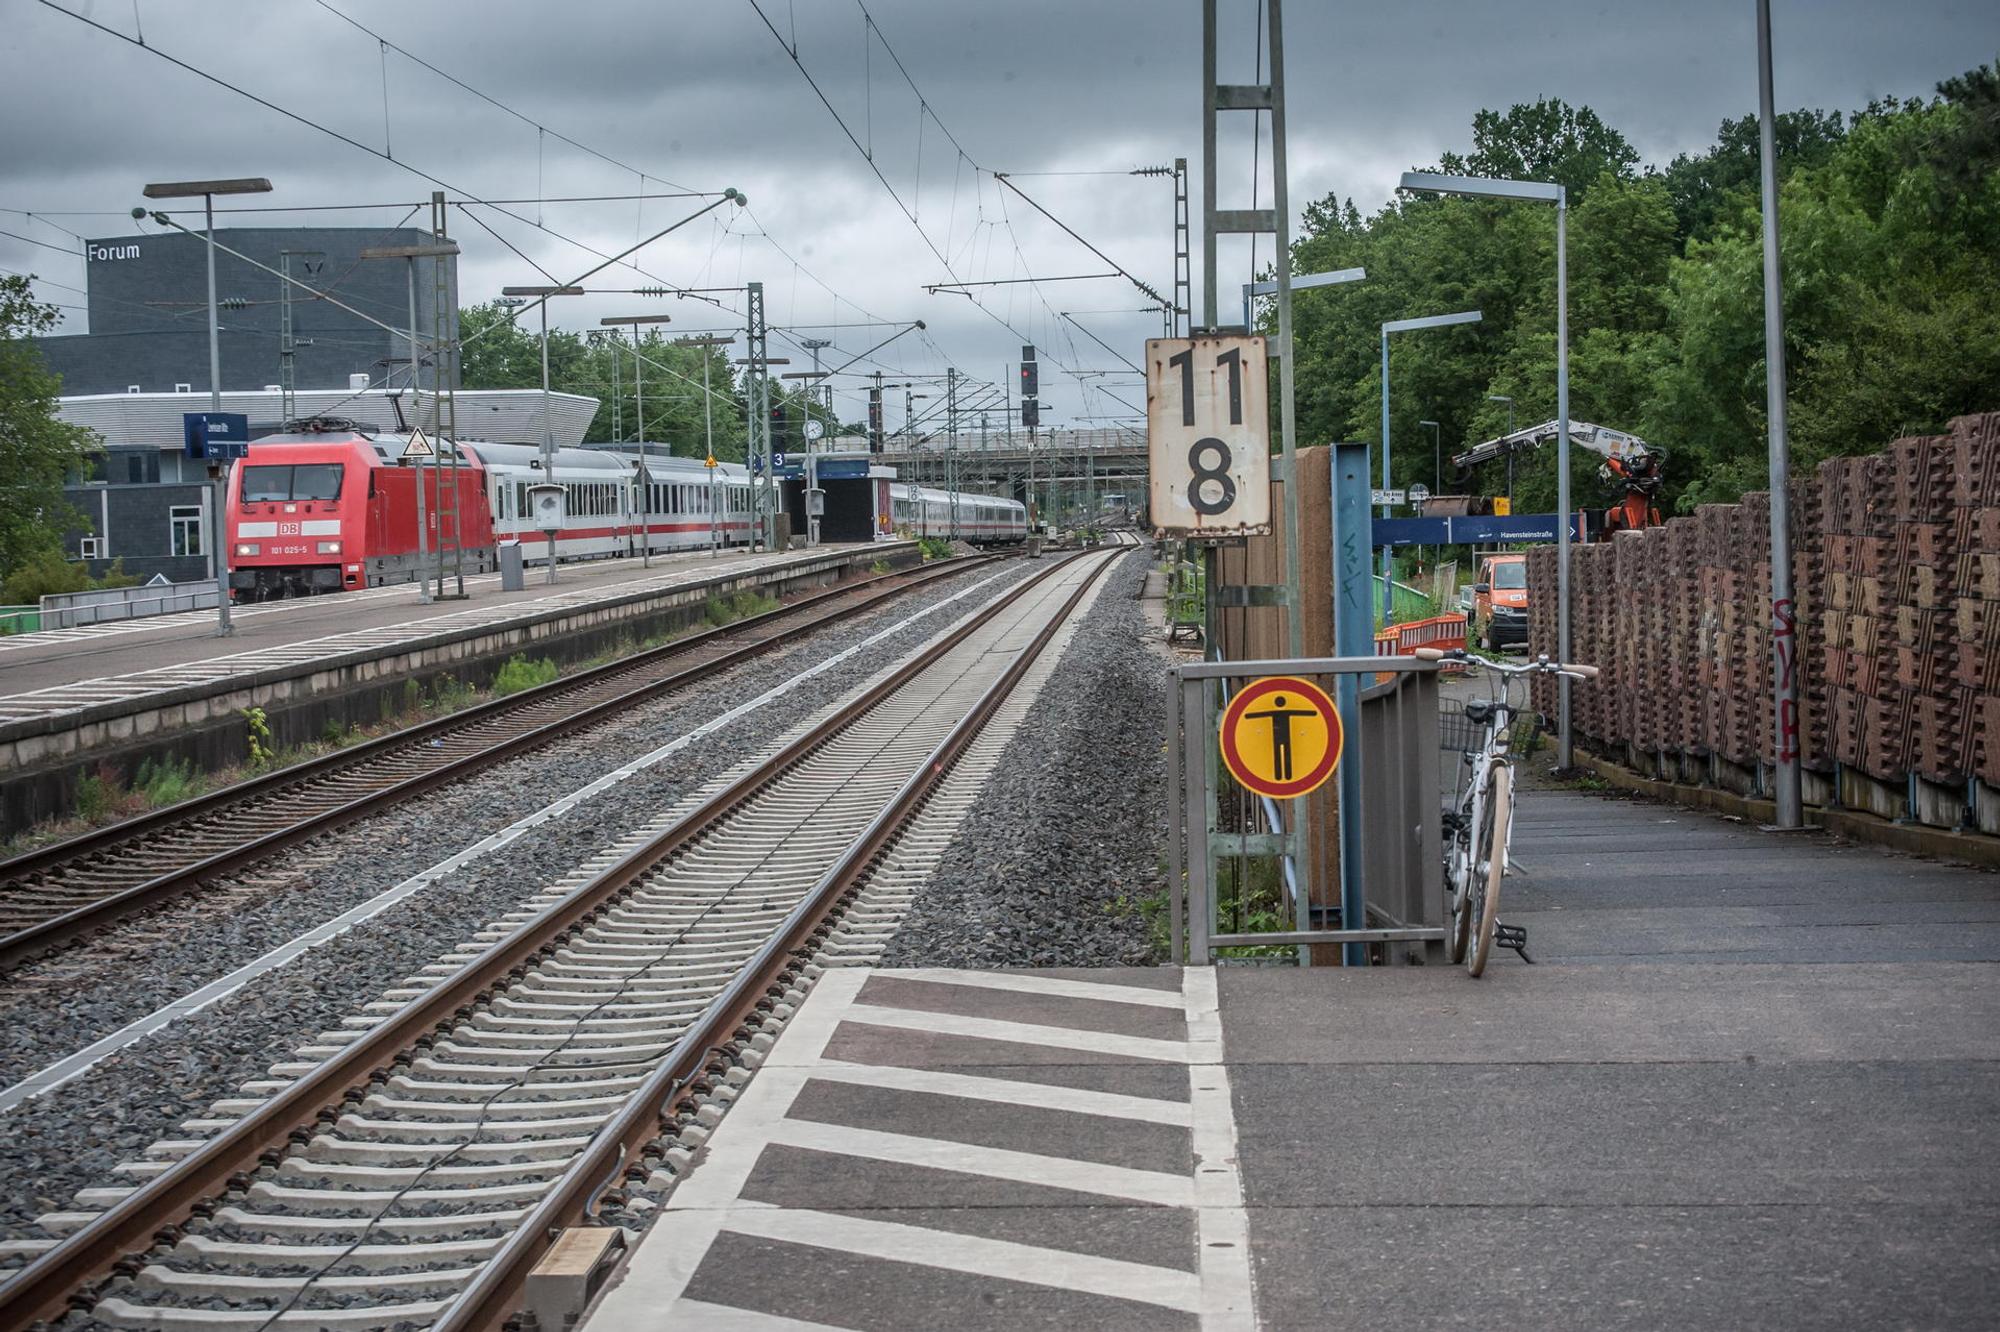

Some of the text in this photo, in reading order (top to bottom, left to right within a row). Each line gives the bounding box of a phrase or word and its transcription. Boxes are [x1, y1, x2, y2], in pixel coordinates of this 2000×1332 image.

[88, 244, 140, 261] Forum
[1169, 347, 1242, 427] 11
[774, 453, 783, 466] 3
[1187, 437, 1236, 516] 8
[910, 485, 918, 493] 12
[281, 523, 298, 534] DB
[1500, 531, 1554, 539] Havensteinstraße
[271, 545, 307, 555] 101 025-5
